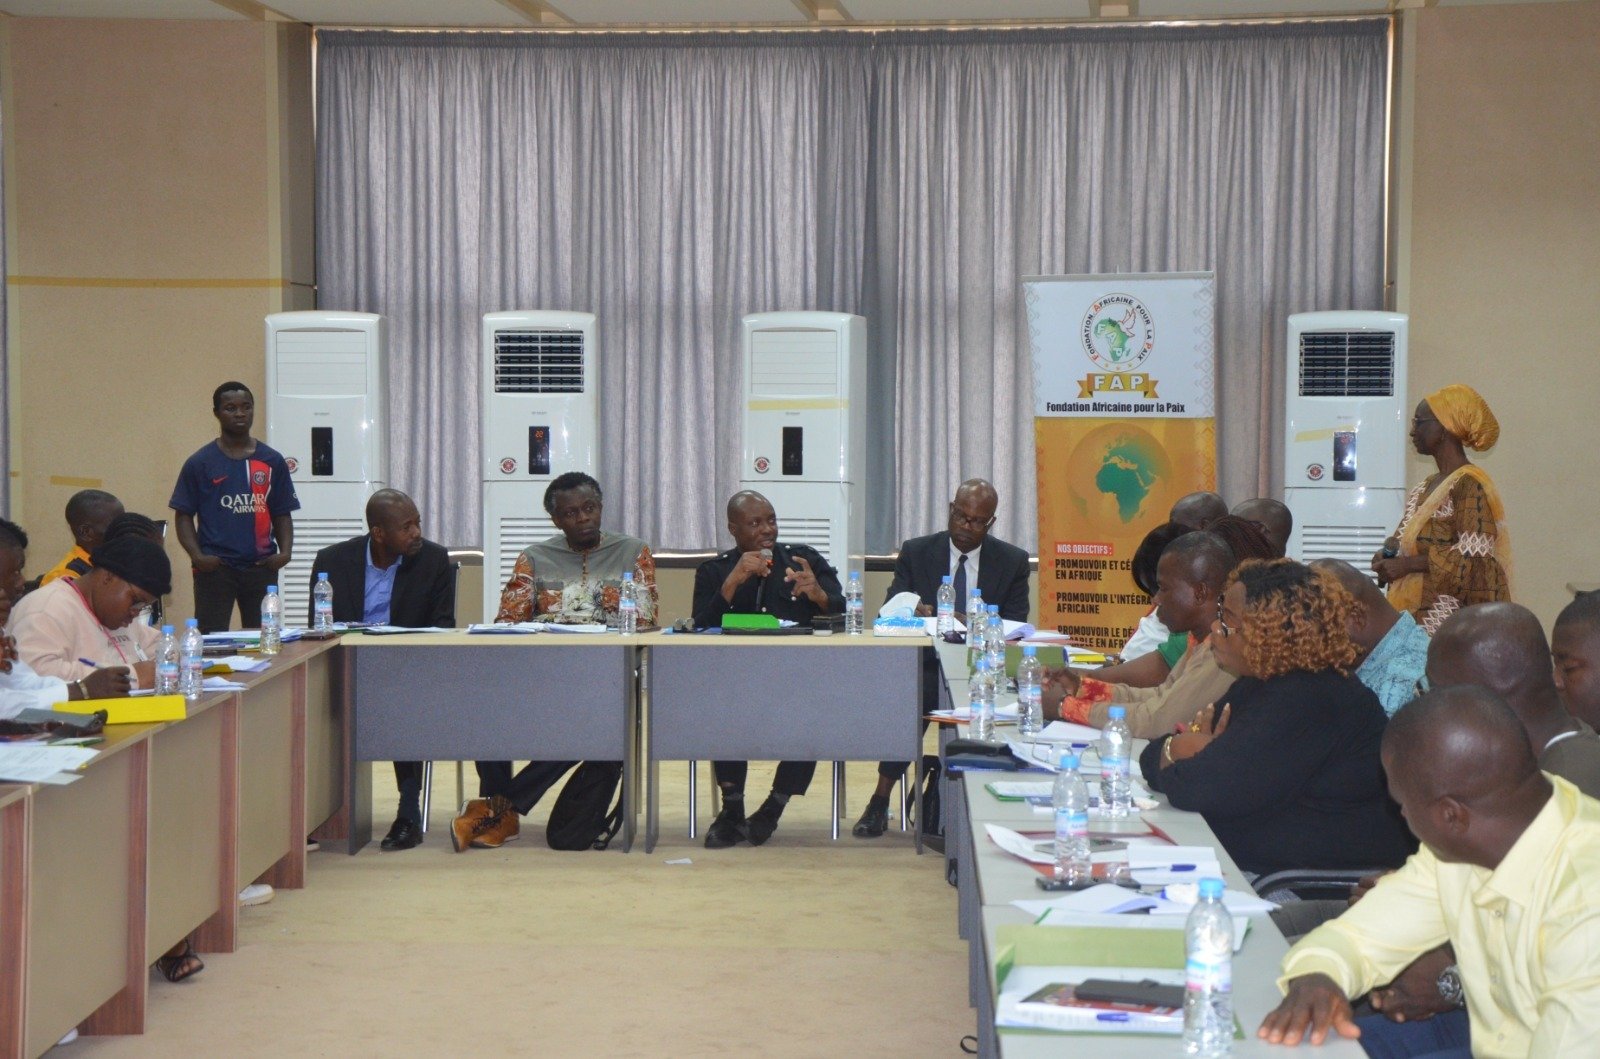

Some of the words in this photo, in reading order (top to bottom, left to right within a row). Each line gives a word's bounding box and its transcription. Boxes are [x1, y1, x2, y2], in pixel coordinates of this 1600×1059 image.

[1046, 401, 1091, 413] Fondation
[1092, 401, 1132, 413] Africaine
[1133, 403, 1155, 414] pour
[1155, 402, 1165, 413] la
[1166, 402, 1186, 414] Paix
[220, 494, 265, 509] QATAR
[233, 505, 266, 514] AIRWAYS
[1057, 544, 1072, 553] NOS
[1072, 544, 1108, 555] OBJECTIFS
[1055, 558, 1107, 570] PROMOUVOIR
[1109, 560, 1119, 570] ET
[1120, 559, 1133, 571] CÉ
[1056, 570, 1067, 580] EN
[1068, 571, 1102, 581] AFRIQUE
[1056, 592, 1108, 604] PROMOUVOIR
[1056, 603, 1100, 614] AFRICAINE
[1057, 625, 1109, 637] PROMOUVOIR
[1111, 627, 1120, 638] LE
[1096, 638, 1107, 648] EN
